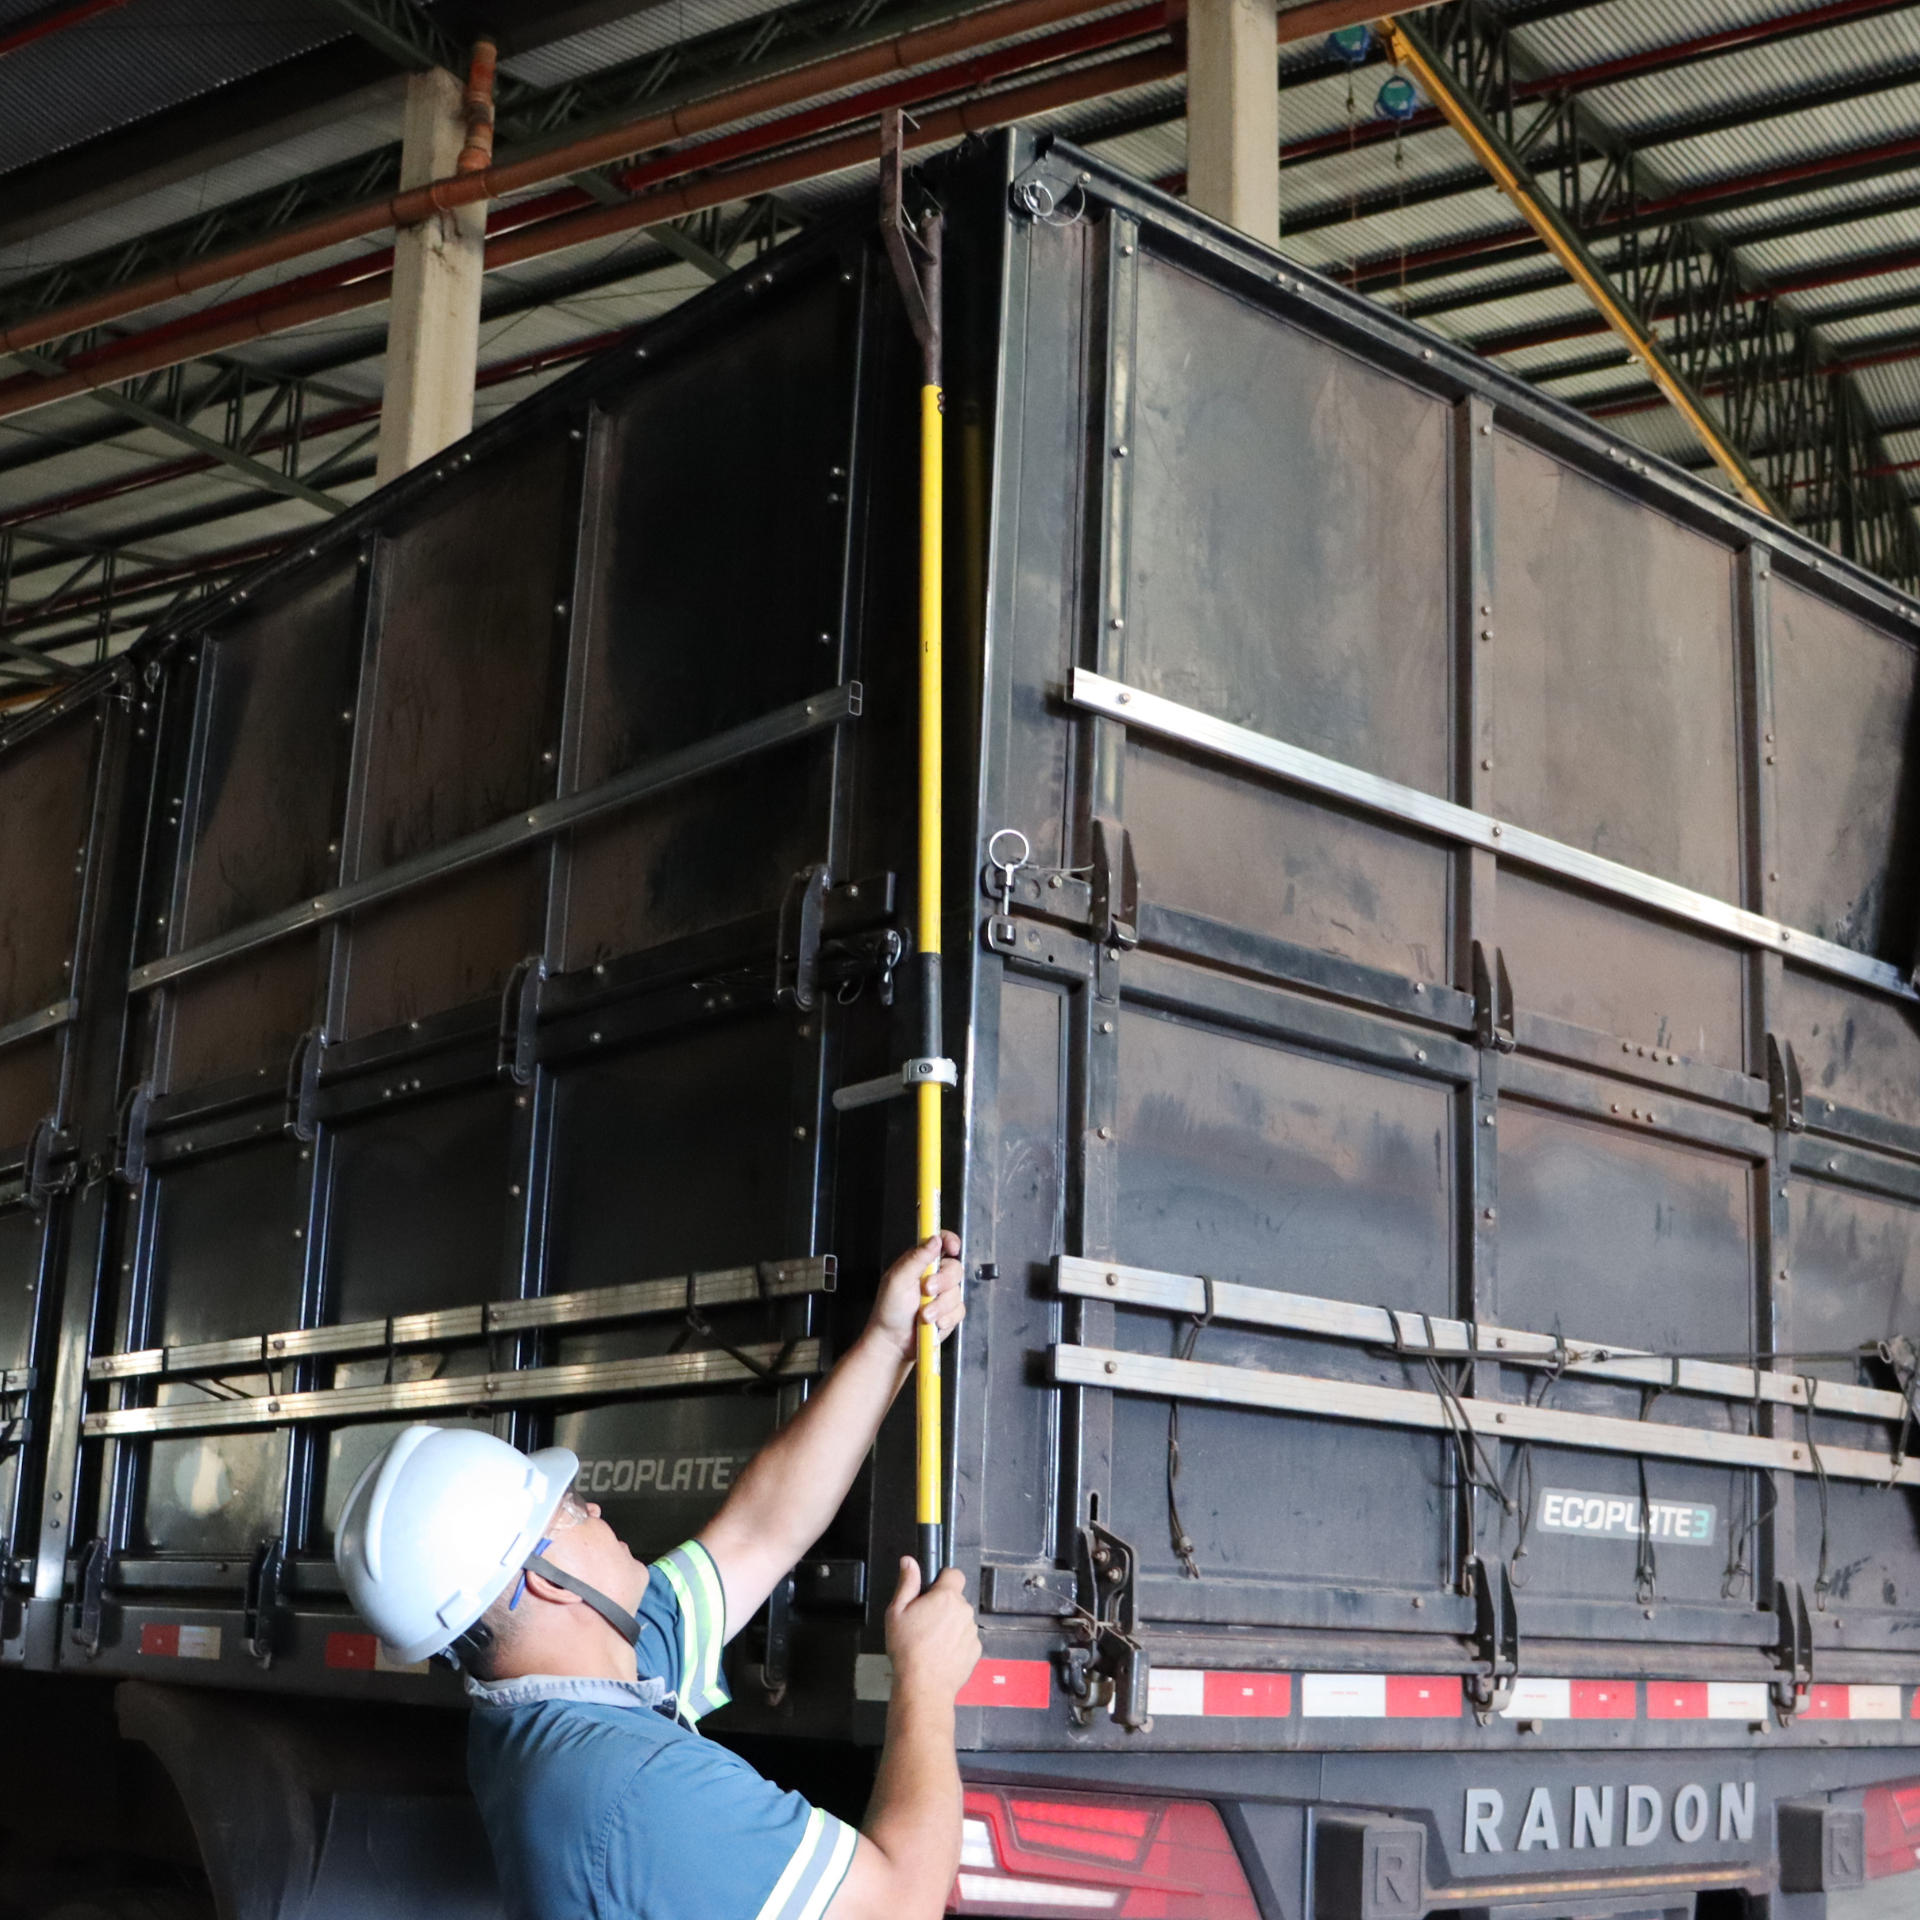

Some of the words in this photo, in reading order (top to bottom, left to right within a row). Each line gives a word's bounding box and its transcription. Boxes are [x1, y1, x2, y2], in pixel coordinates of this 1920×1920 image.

[574, 1456, 749, 1492] ECOPLATE
[1543, 1494, 1710, 1539] ECOPLATE3
[1462, 1782, 1756, 1853] RANDON
